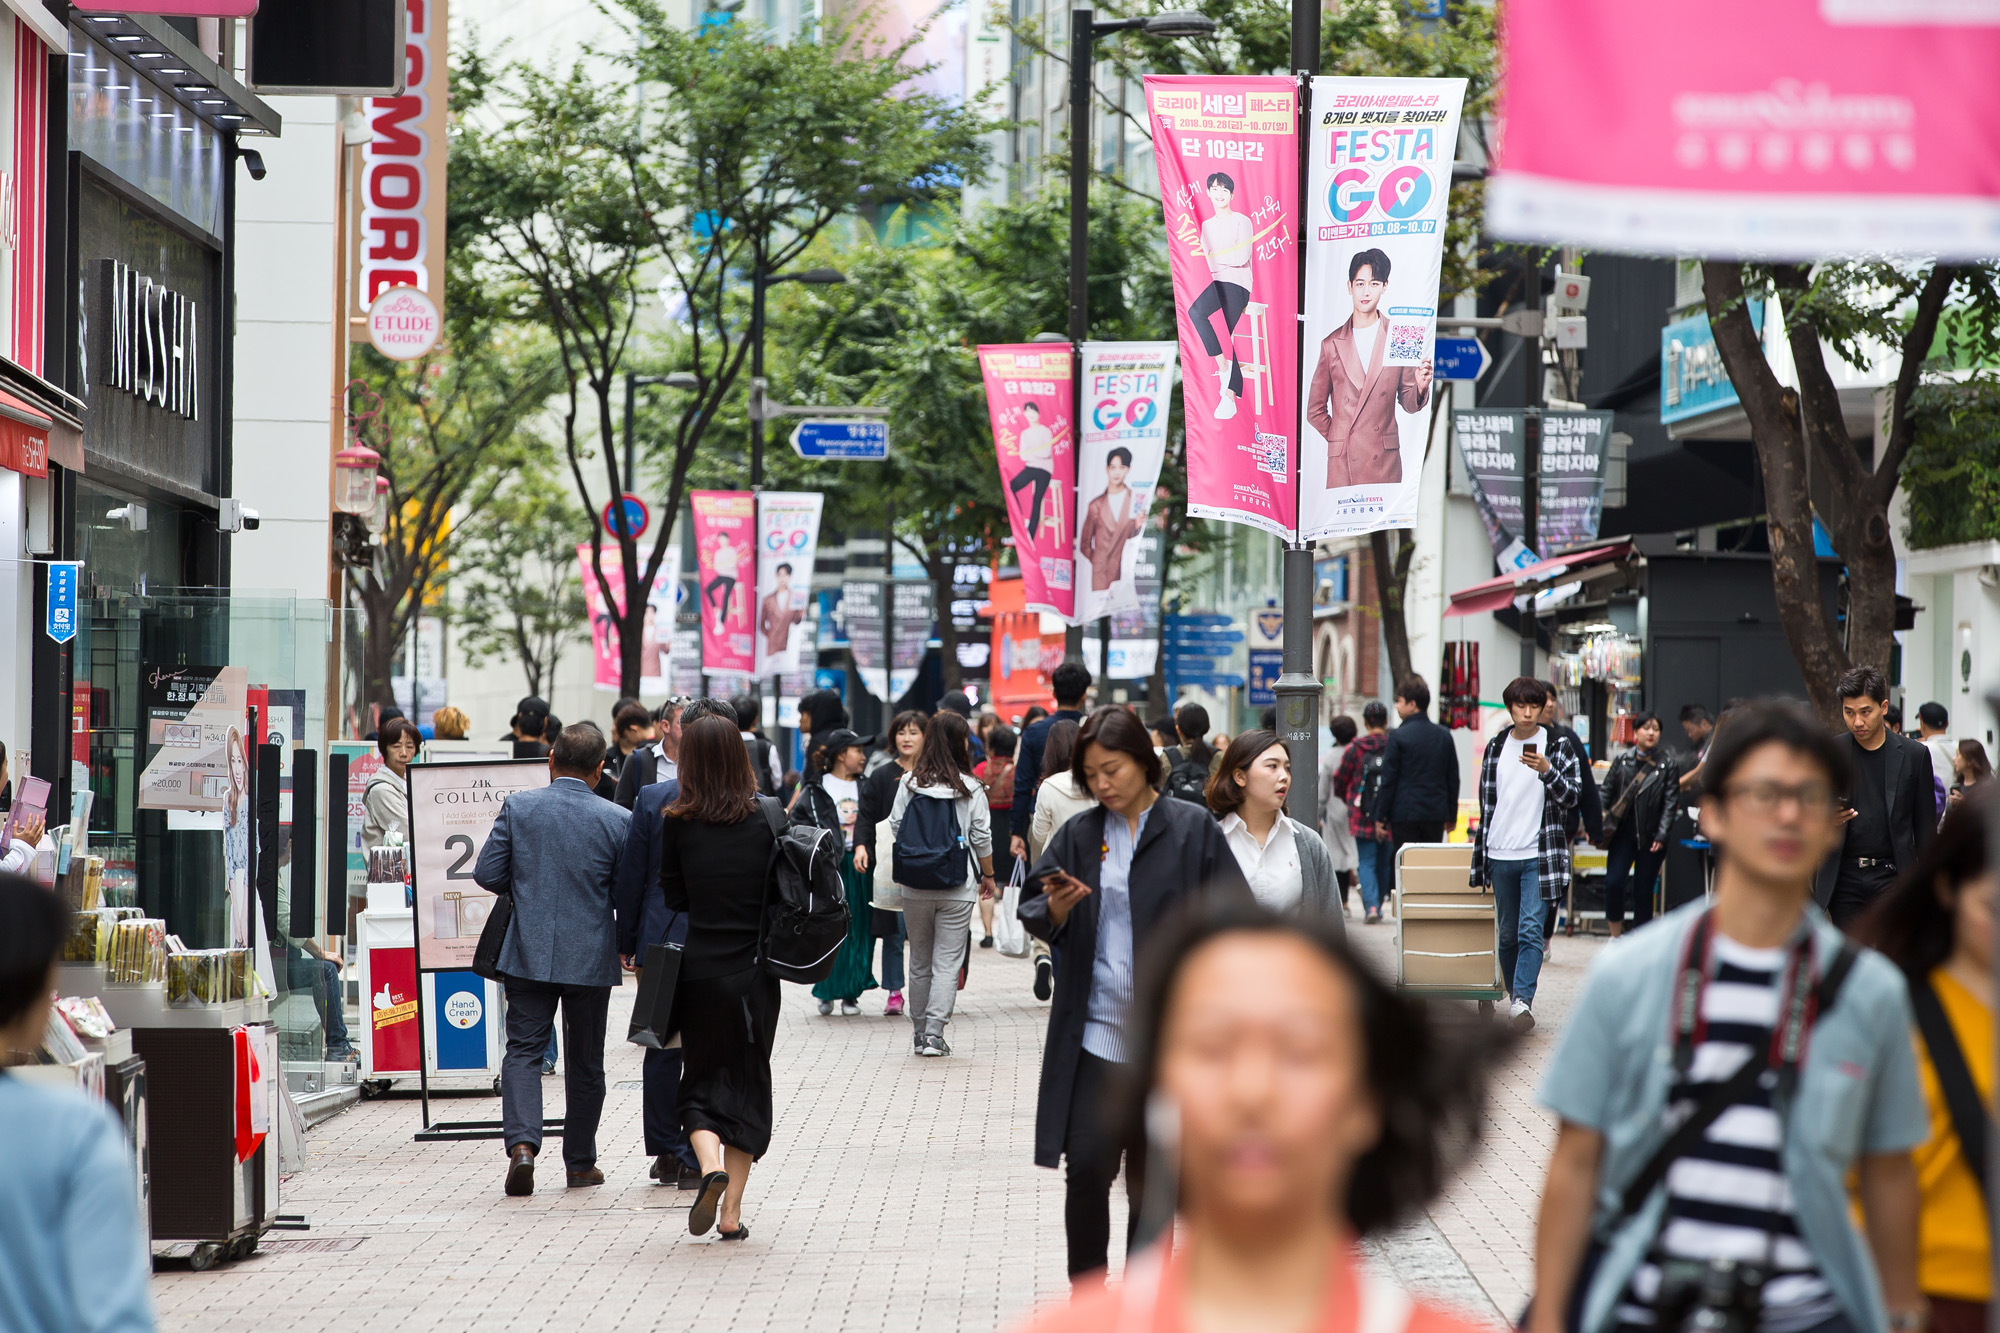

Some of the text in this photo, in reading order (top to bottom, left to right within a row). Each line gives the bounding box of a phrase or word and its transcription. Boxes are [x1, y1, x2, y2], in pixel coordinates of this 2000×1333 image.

[1157, 94, 1291, 115] 코리아 세일 페스타
[1332, 95, 1440, 108] 코리아세일페스타
[1322, 110, 1448, 125] 8개의 뱃지를 찾아라!
[1180, 137, 1265, 162] 단 10일간
[1330, 128, 1433, 164] FESTA
[1328, 165, 1432, 223] GO
[1319, 223, 1369, 240] 이벤트기간
[374, 315, 434, 331] ETUDE
[111, 259, 198, 421] MISSHA
[382, 332, 425, 343] HOUSE
[1094, 374, 1158, 395] FESTA
[1093, 396, 1157, 431] GO
[1543, 417, 1602, 435] 금난새의
[1542, 436, 1586, 454] 클래식
[1467, 452, 1517, 471] 타지아
[1542, 454, 1600, 472] 판타지아
[471, 779, 492, 788] 24K
[434, 790, 530, 805] COLLAG
[460, 811, 477, 819] Gold
[391, 992, 404, 1001] BEST
[451, 1000, 475, 1008] Hand
[449, 1009, 479, 1017] Cream
